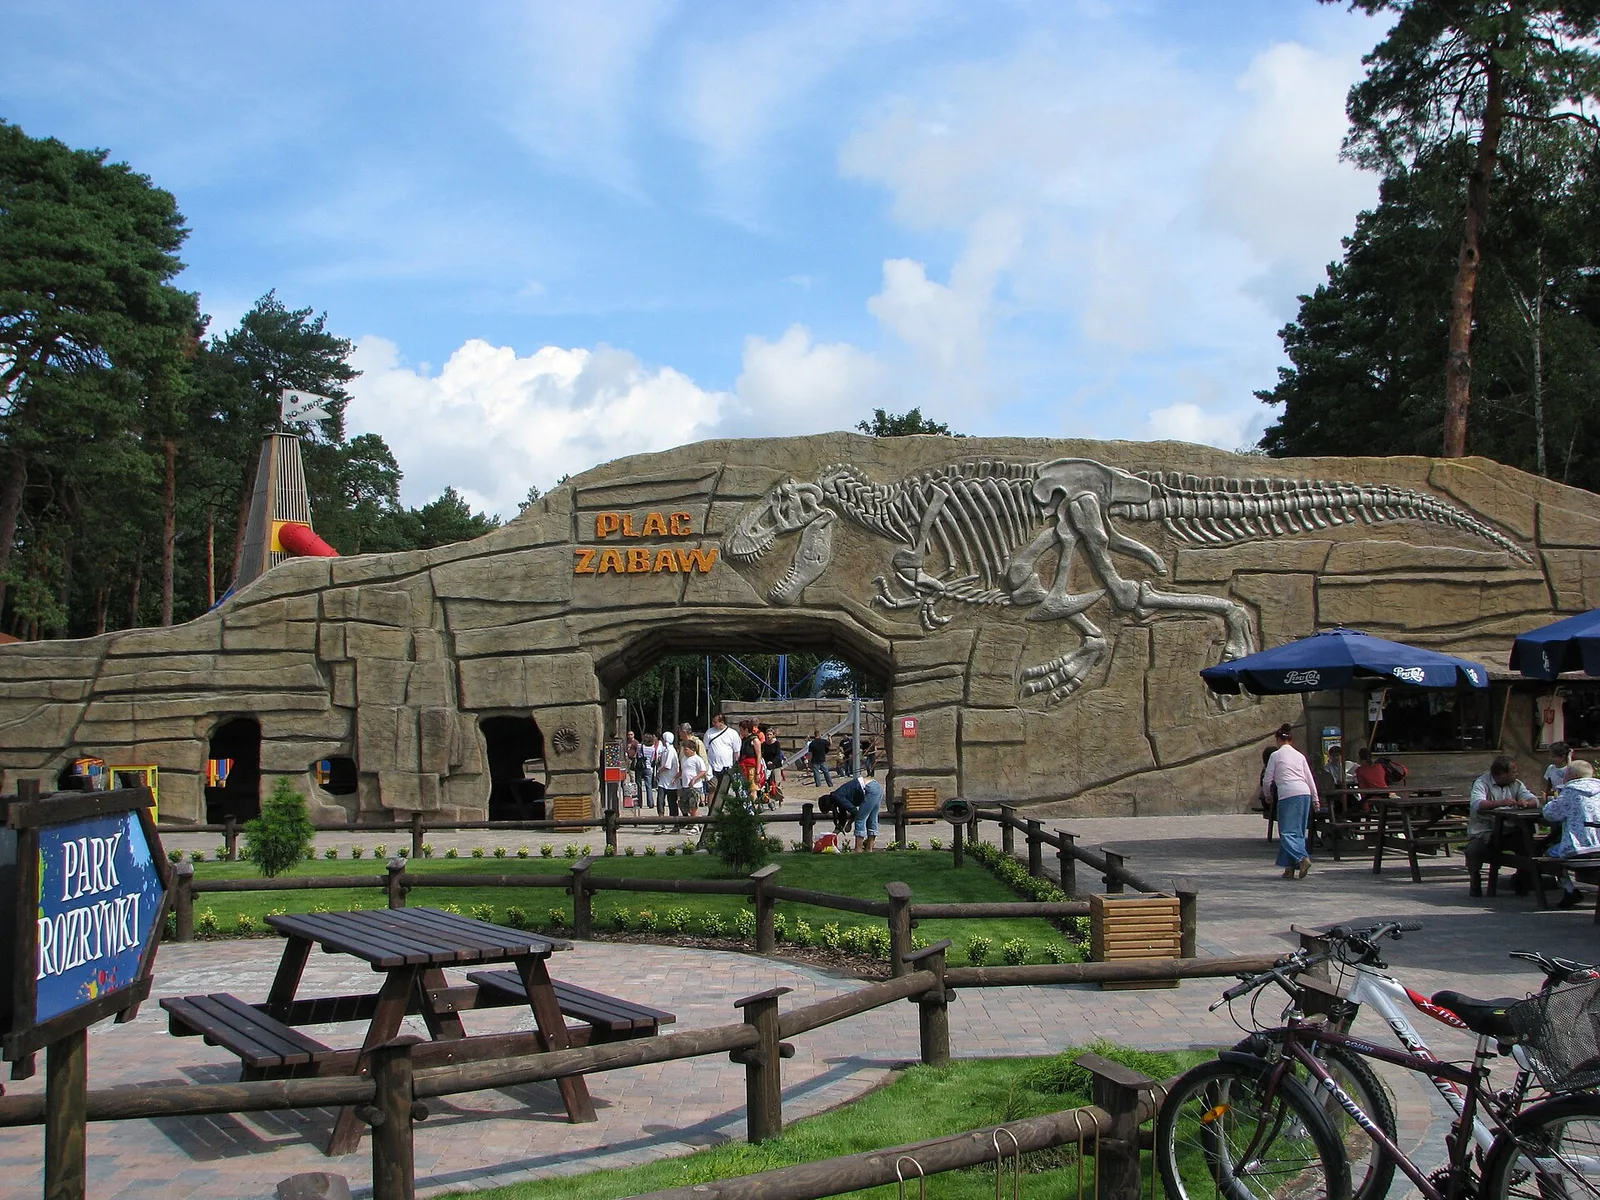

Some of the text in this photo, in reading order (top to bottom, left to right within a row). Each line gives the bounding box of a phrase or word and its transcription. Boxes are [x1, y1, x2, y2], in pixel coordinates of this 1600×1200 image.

[596, 512, 691, 538] PLAC
[574, 548, 718, 574] ZABAW
[61, 832, 123, 902] PARK
[37, 892, 142, 980] ROZRYWKI
[1350, 1041, 1374, 1054] GIANT
[1332, 1087, 1376, 1128] GIANT
